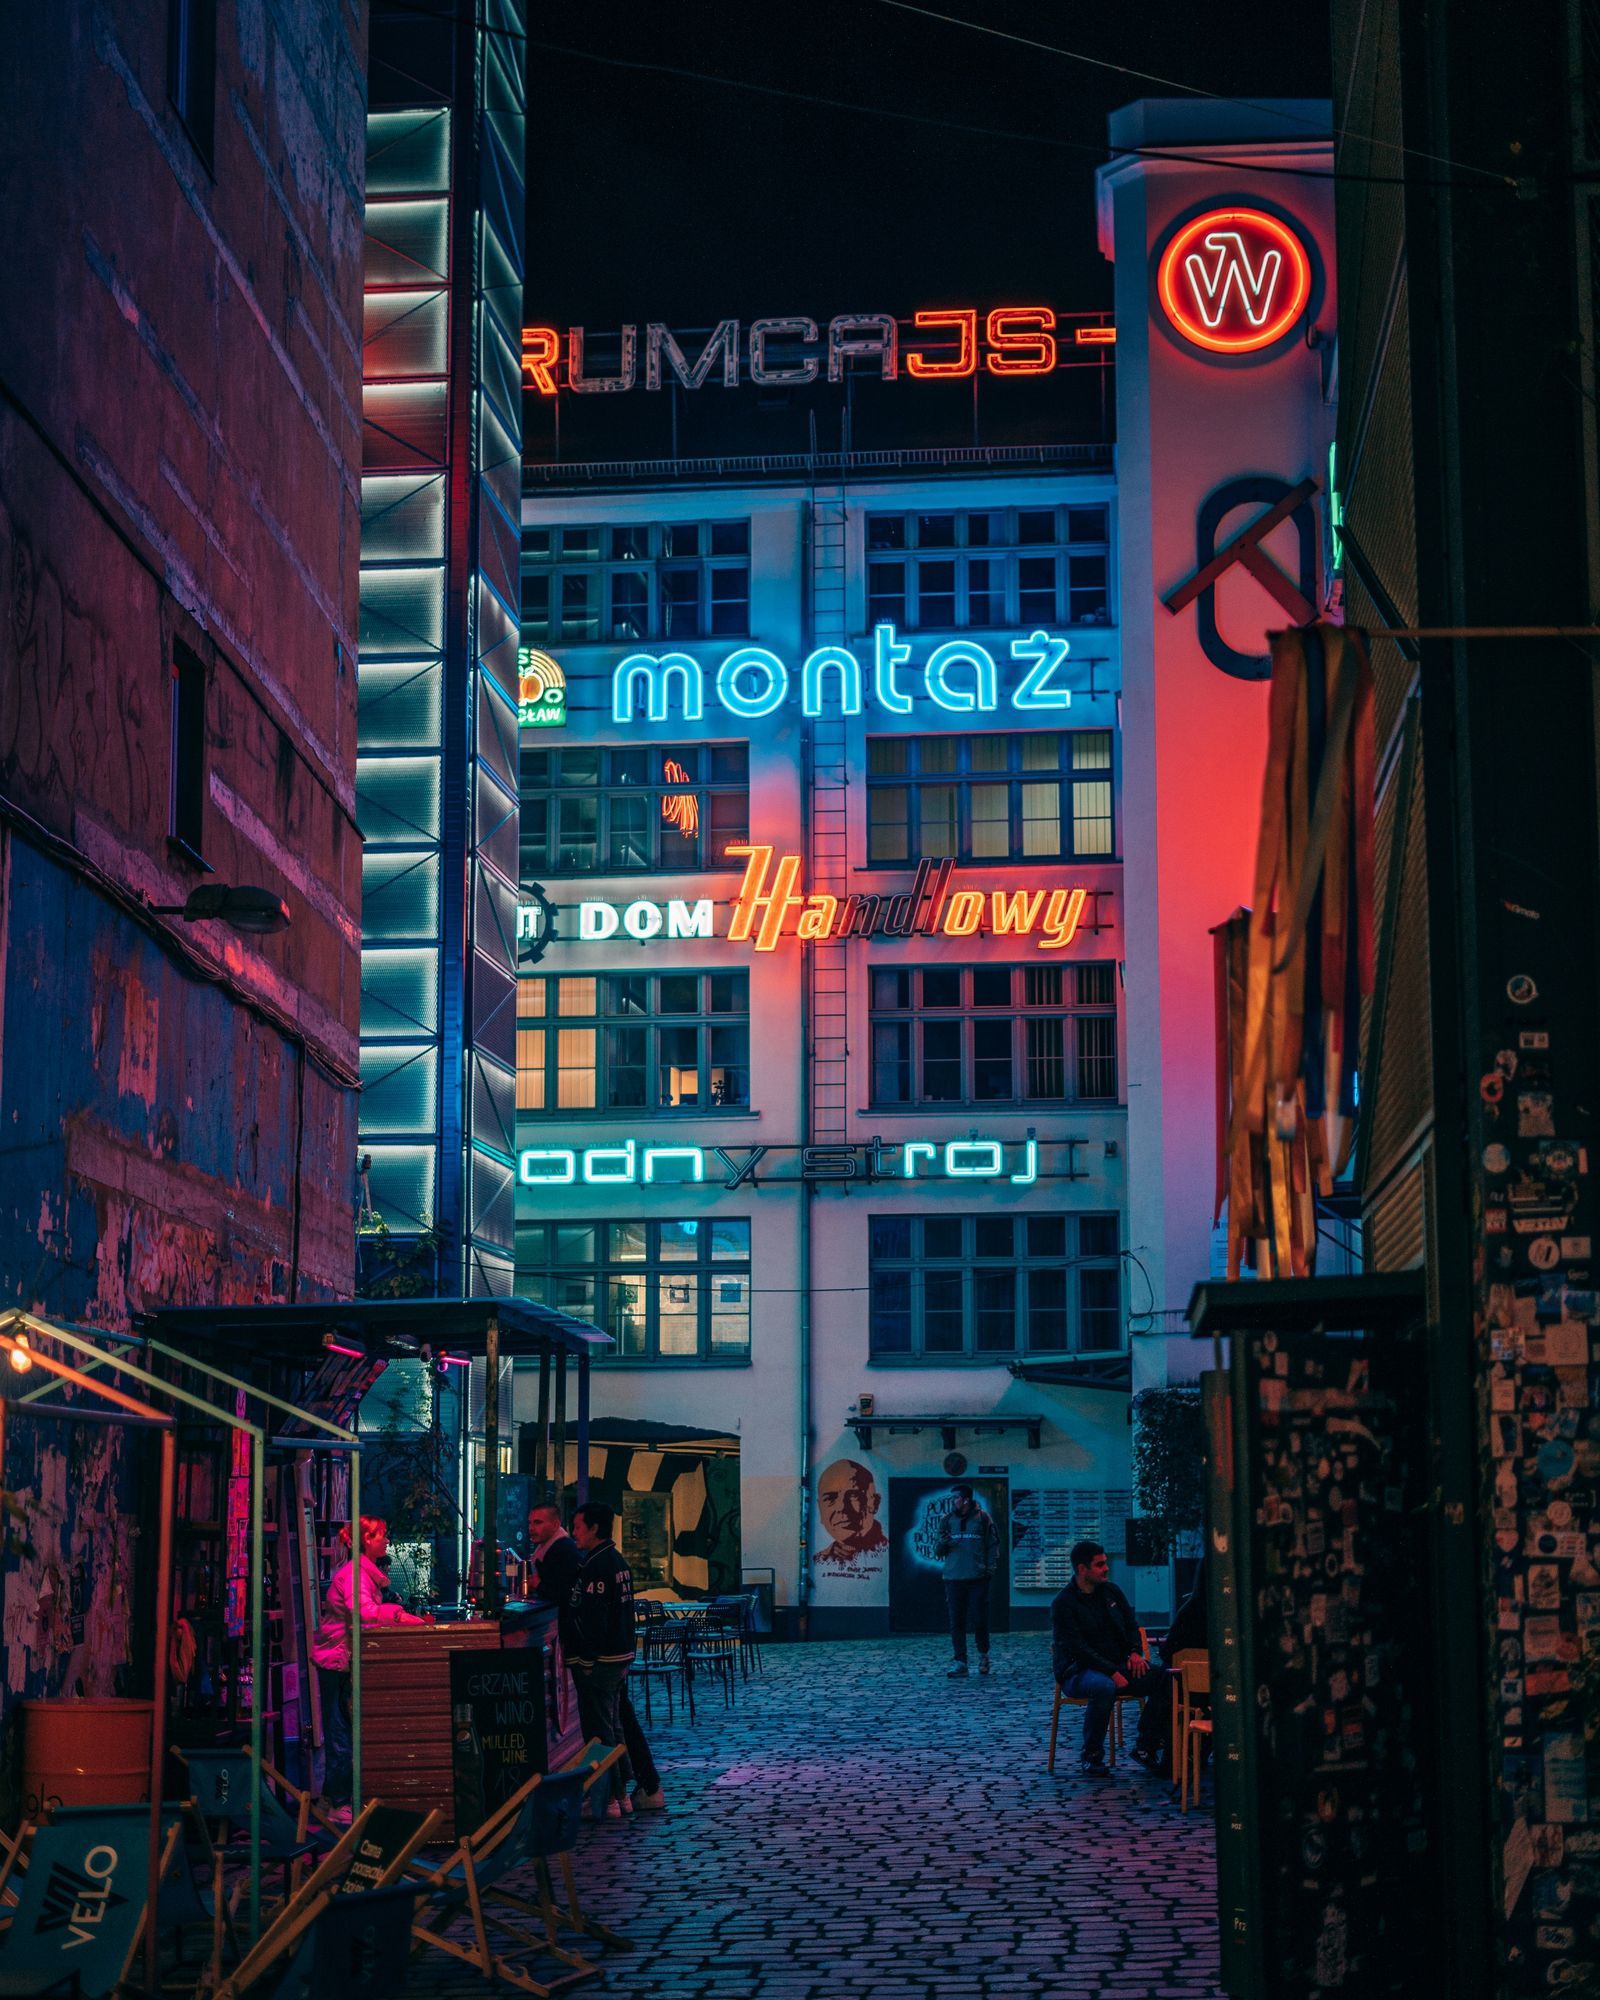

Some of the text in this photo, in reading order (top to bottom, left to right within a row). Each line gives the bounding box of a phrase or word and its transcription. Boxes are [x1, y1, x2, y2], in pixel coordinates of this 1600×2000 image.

[612, 622, 1072, 723] montaż
[579, 844, 1088, 952] DOM Handlowy
[467, 1671, 529, 1696] GRZANE
[495, 1699, 535, 1725] WINO
[481, 1732, 526, 1750] MULLED
[501, 1749, 529, 1764] WINE
[220, 1768, 230, 1805] VELO
[60, 1844, 119, 1950] VELO
